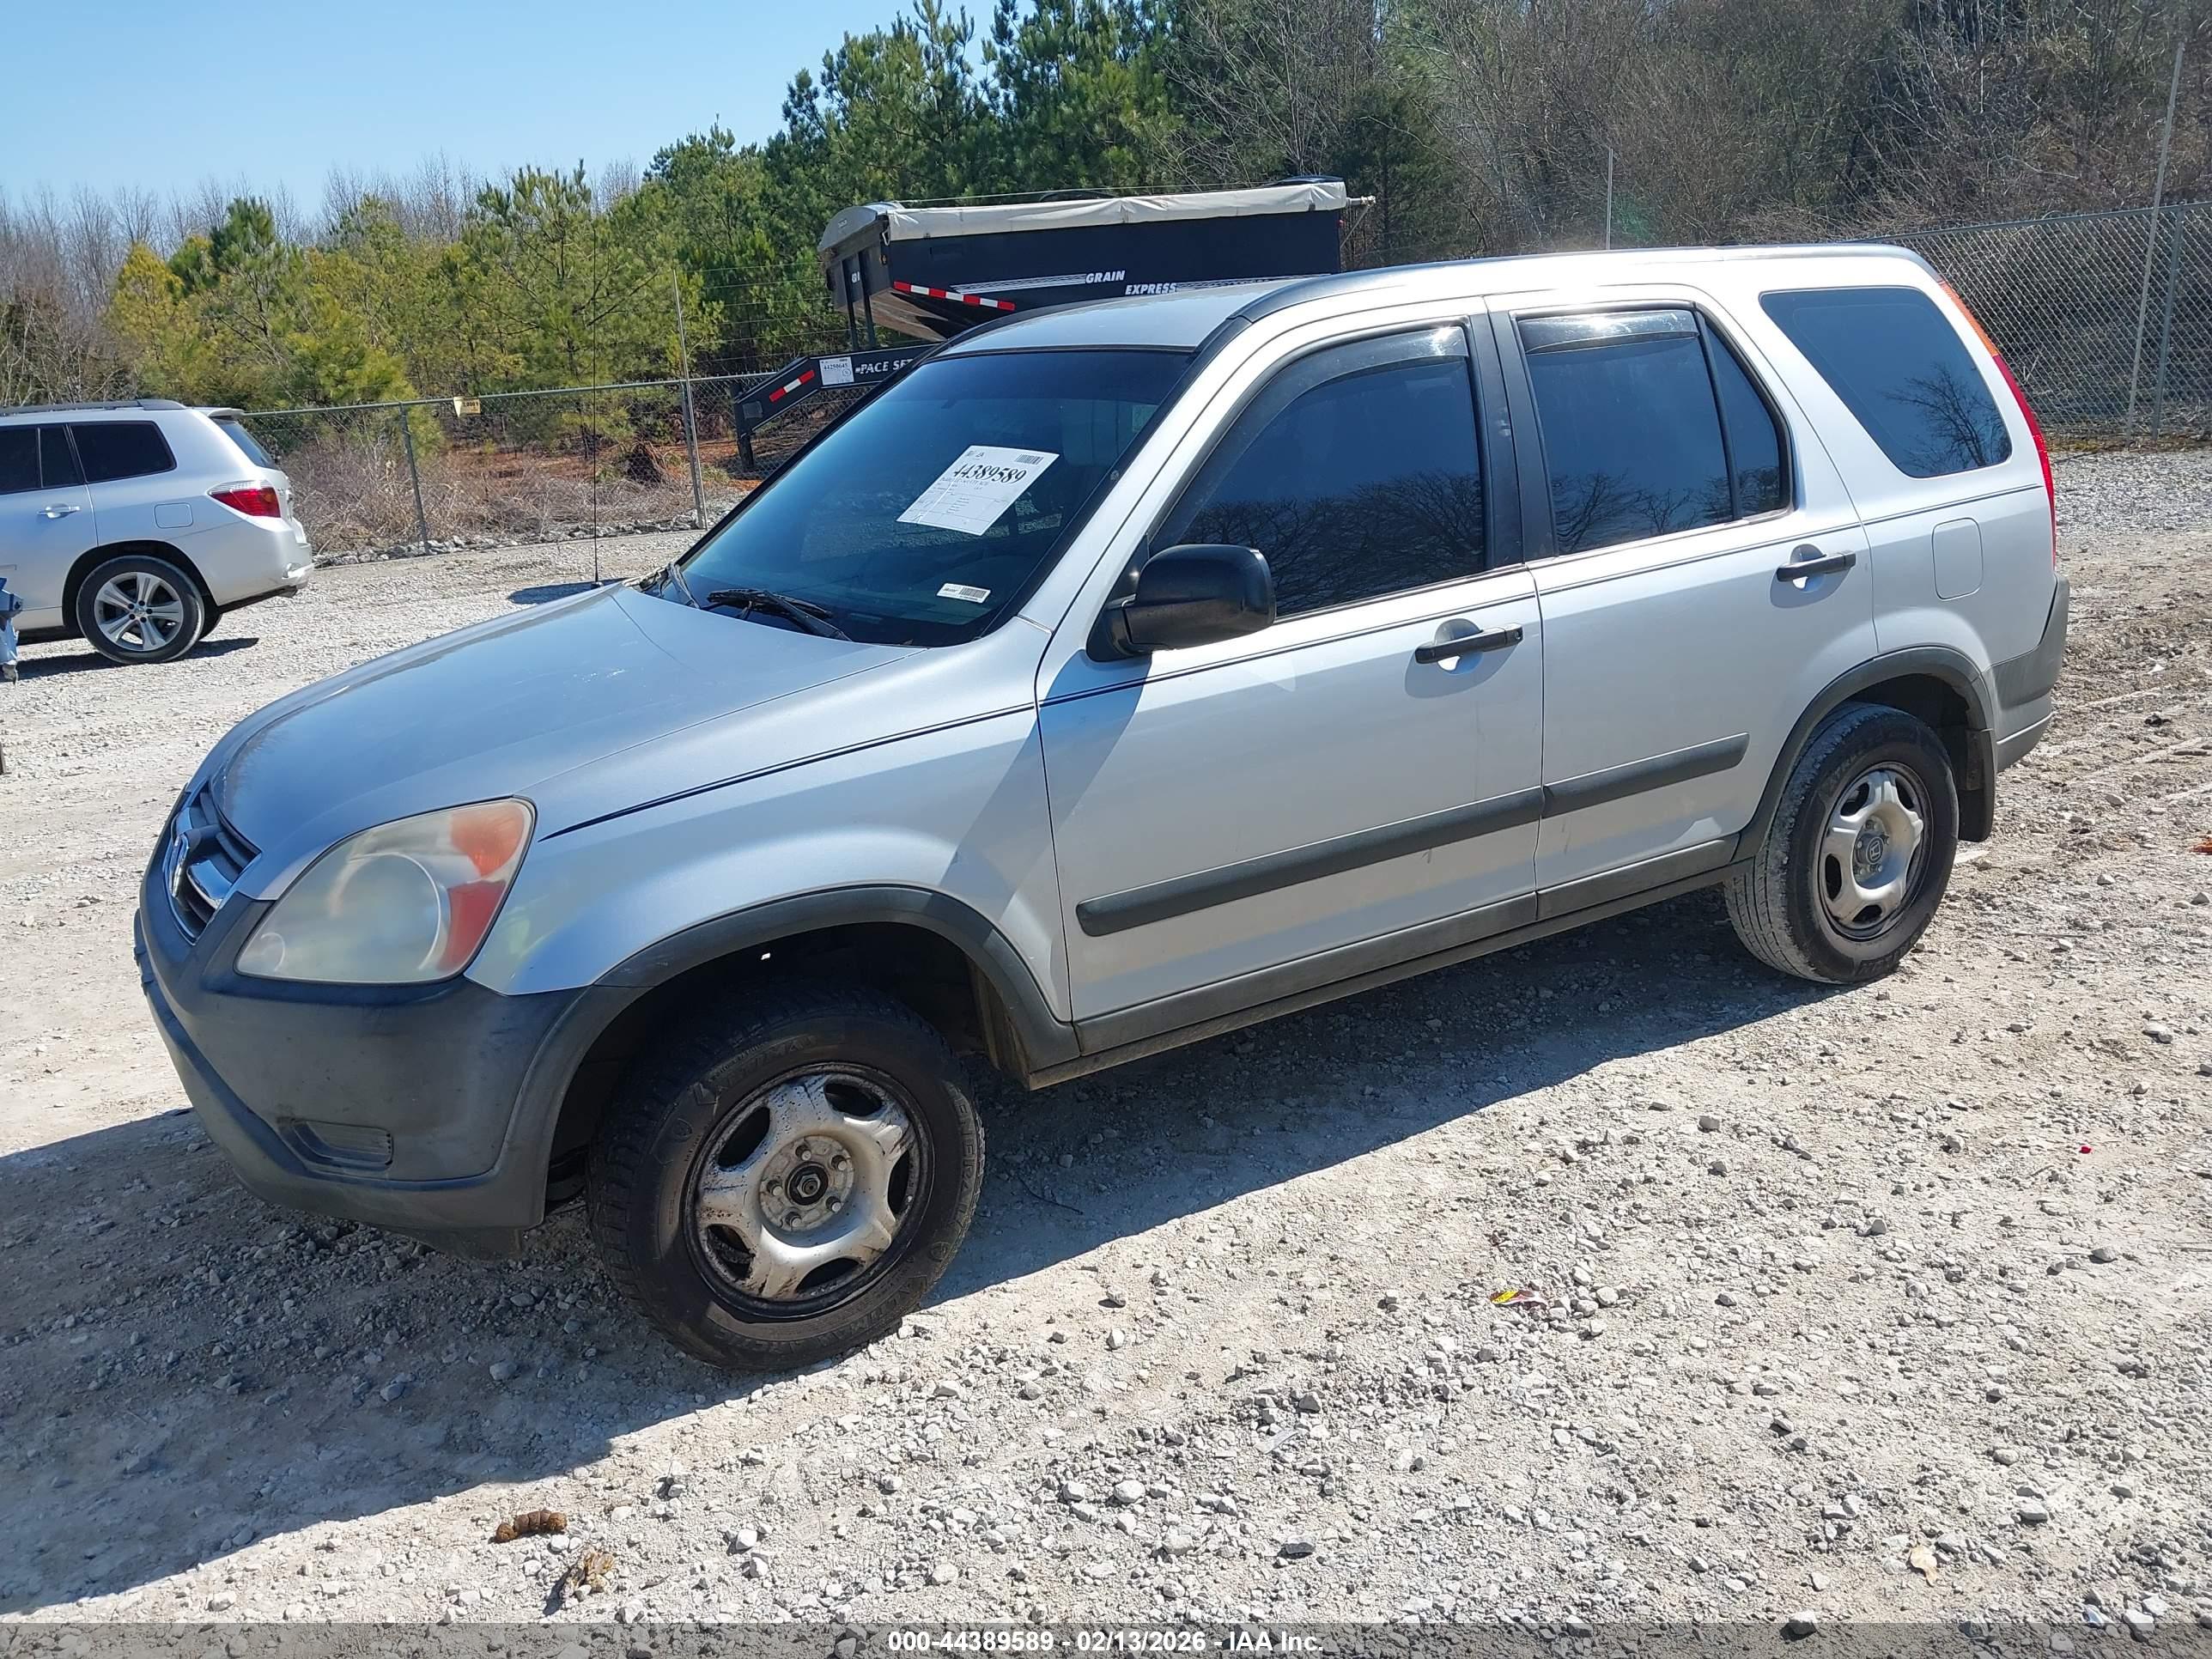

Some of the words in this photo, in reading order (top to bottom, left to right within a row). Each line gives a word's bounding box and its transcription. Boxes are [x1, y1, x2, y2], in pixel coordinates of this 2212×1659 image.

[1085, 270, 1126, 283] GRAIN
[1125, 282, 1177, 295] EXPRESS
[860, 361, 890, 374] PACE
[953, 463, 1027, 484] 44389589
